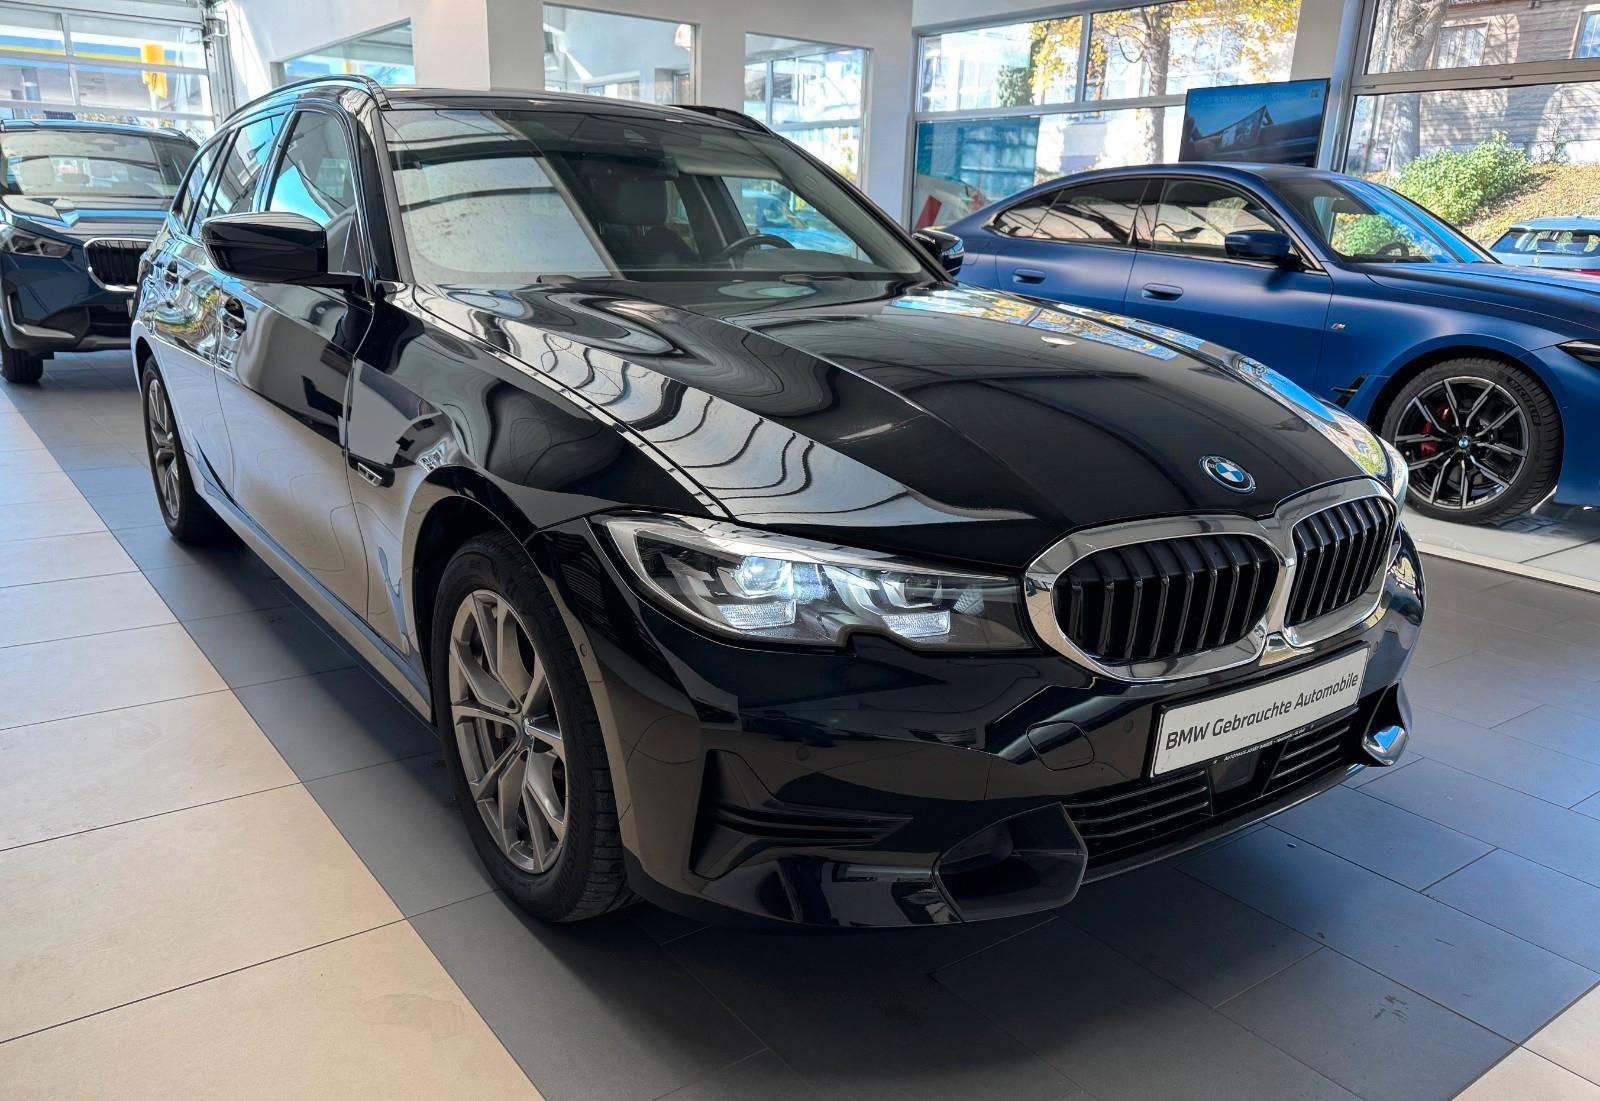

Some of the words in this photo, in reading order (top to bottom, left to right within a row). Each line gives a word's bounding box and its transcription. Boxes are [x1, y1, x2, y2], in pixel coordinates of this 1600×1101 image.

[1165, 722, 1211, 750] BMW
[1212, 699, 1292, 736] Gebrauchte
[1293, 672, 1359, 710] Automobile
